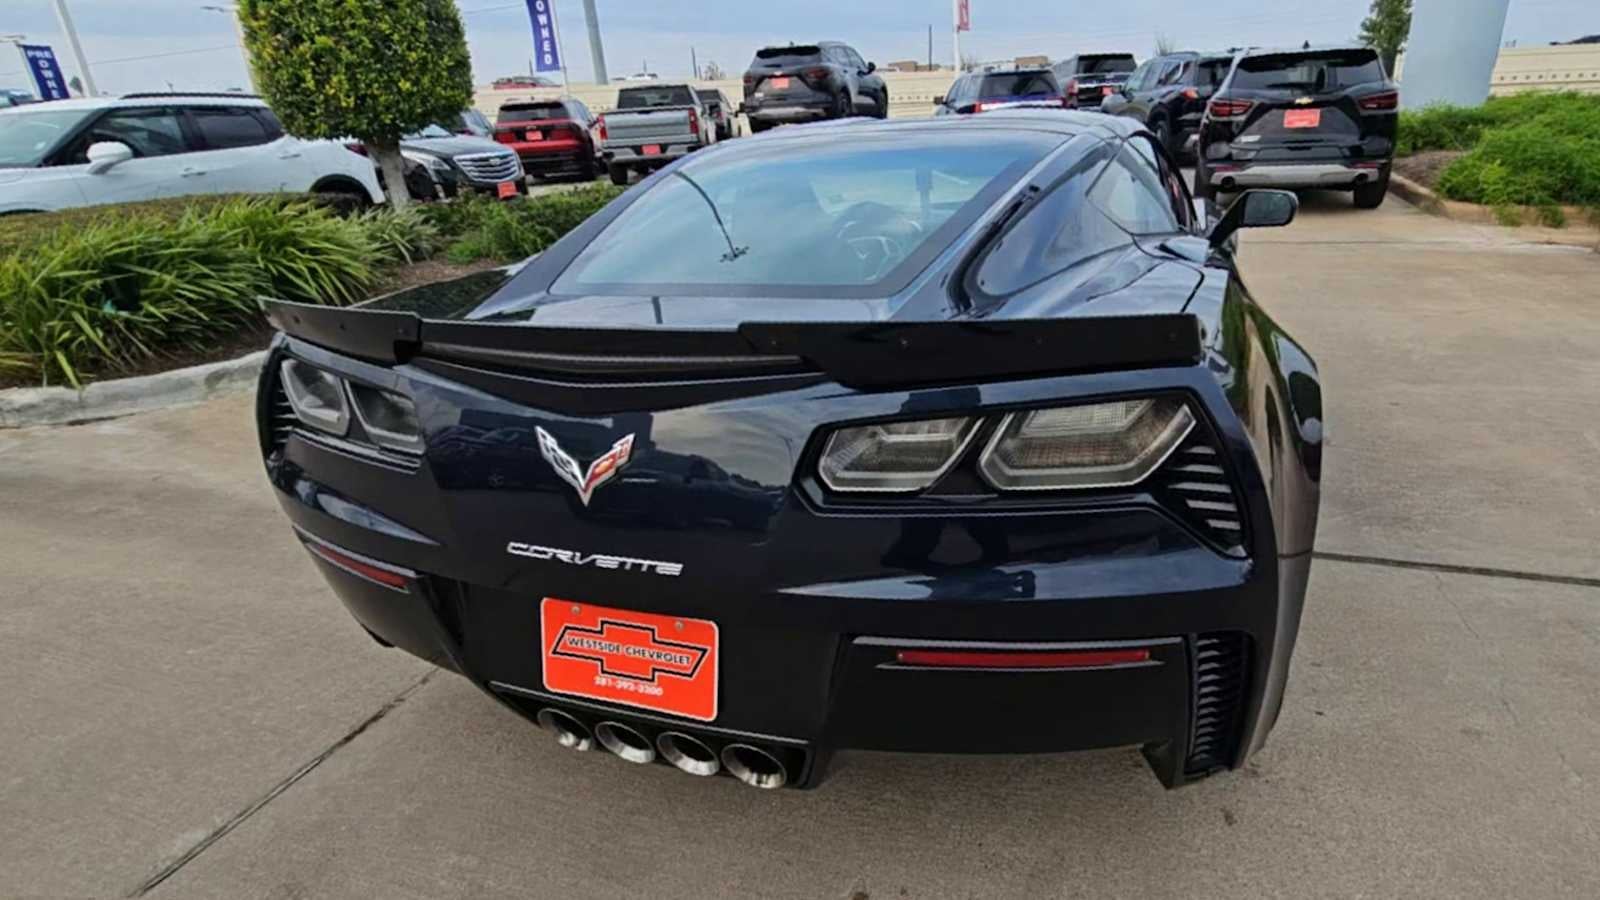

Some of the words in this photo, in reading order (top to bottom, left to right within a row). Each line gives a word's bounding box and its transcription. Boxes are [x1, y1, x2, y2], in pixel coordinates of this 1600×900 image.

[535, 0, 552, 65] OWNED
[27, 50, 52, 58] PRE
[38, 59, 60, 98] OWNE
[507, 541, 683, 576] CORVETTE
[567, 636, 620, 651] WESTSIDE
[625, 646, 691, 664] CHEVROLET
